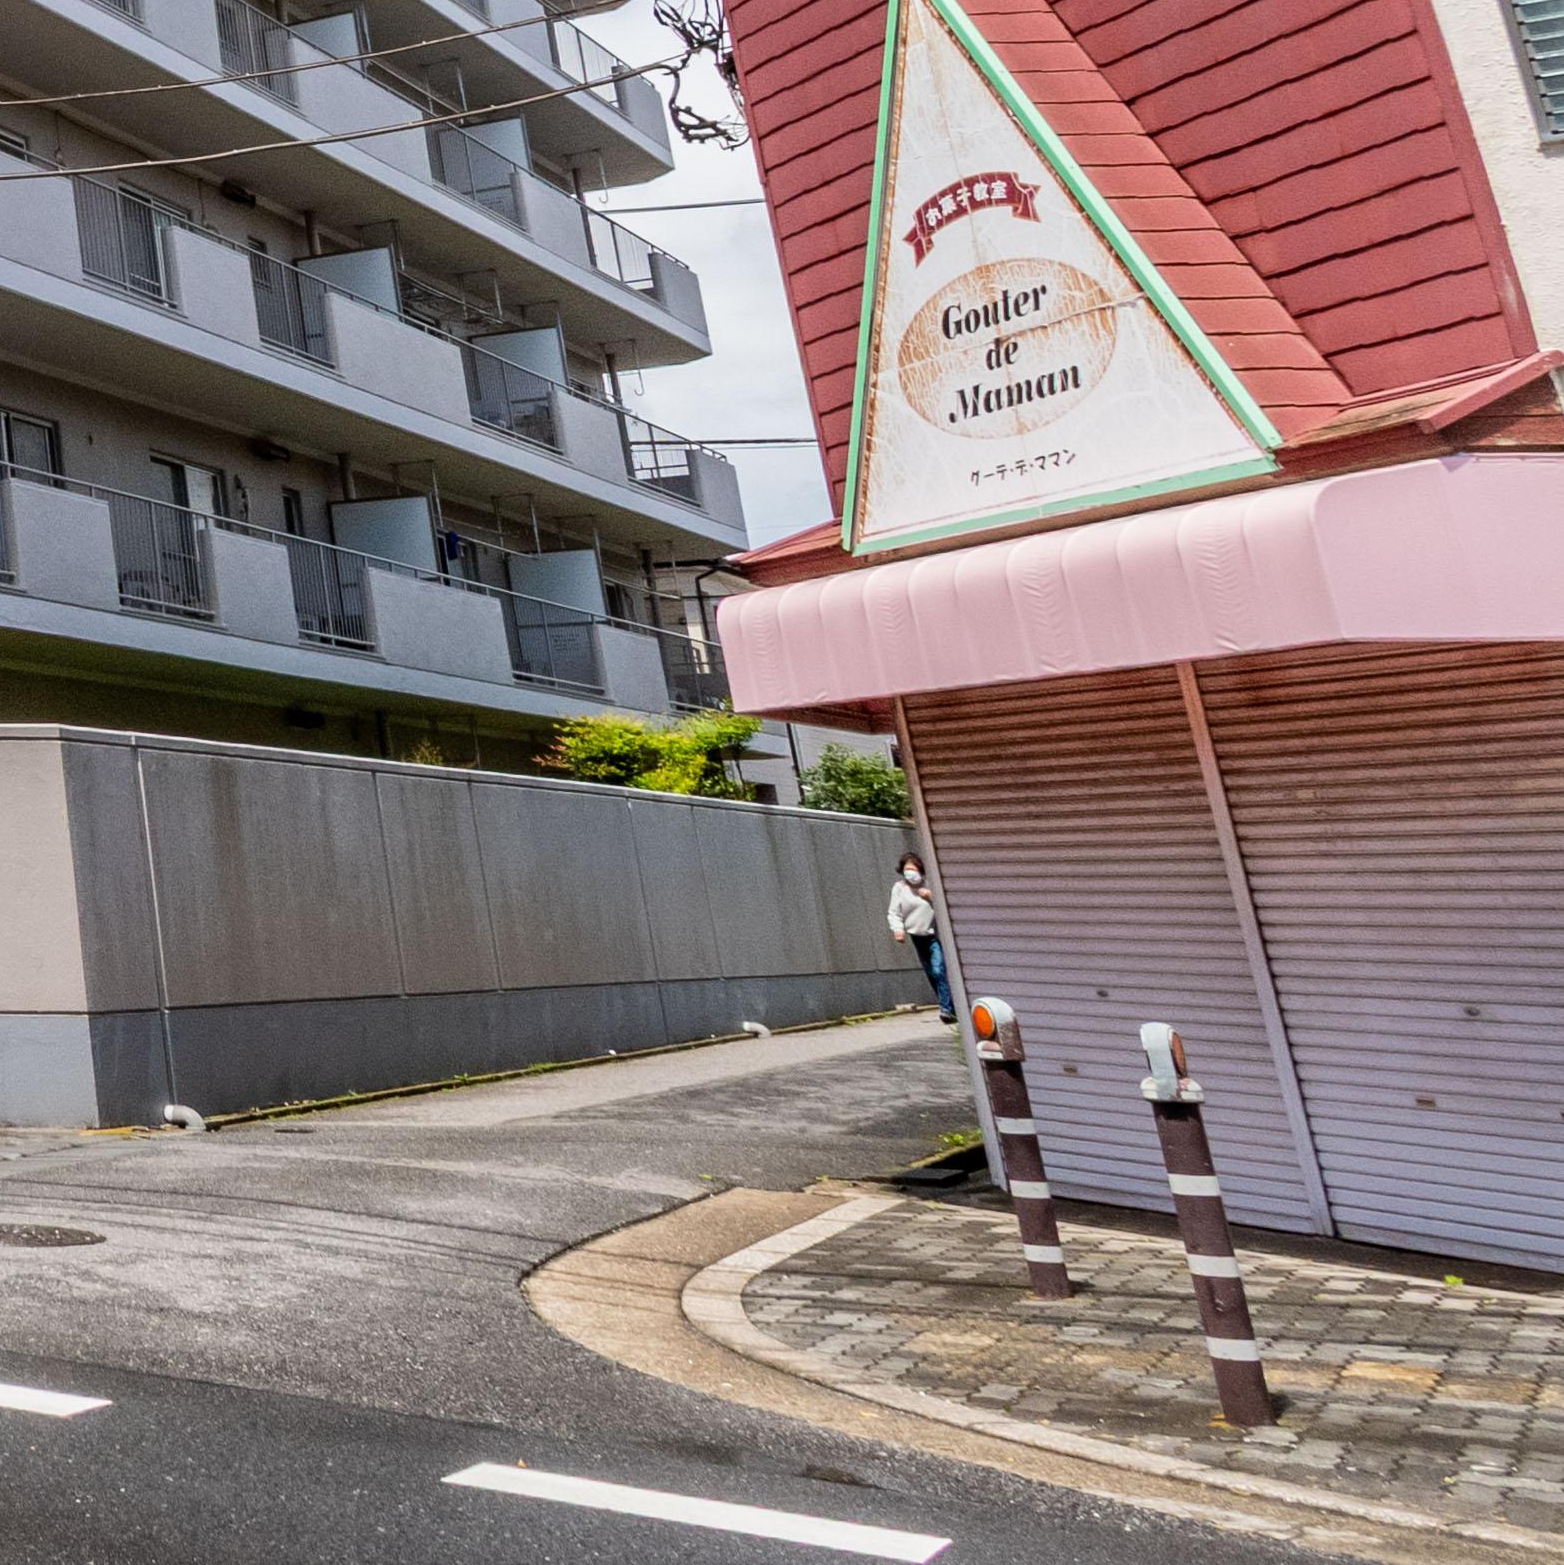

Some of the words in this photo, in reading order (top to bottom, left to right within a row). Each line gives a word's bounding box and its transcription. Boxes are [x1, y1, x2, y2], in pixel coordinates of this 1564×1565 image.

[926, 180, 1007, 226] お菓子教室
[942, 284, 1047, 340] Gouter
[986, 337, 1019, 370] de
[949, 365, 1082, 423] Maman
